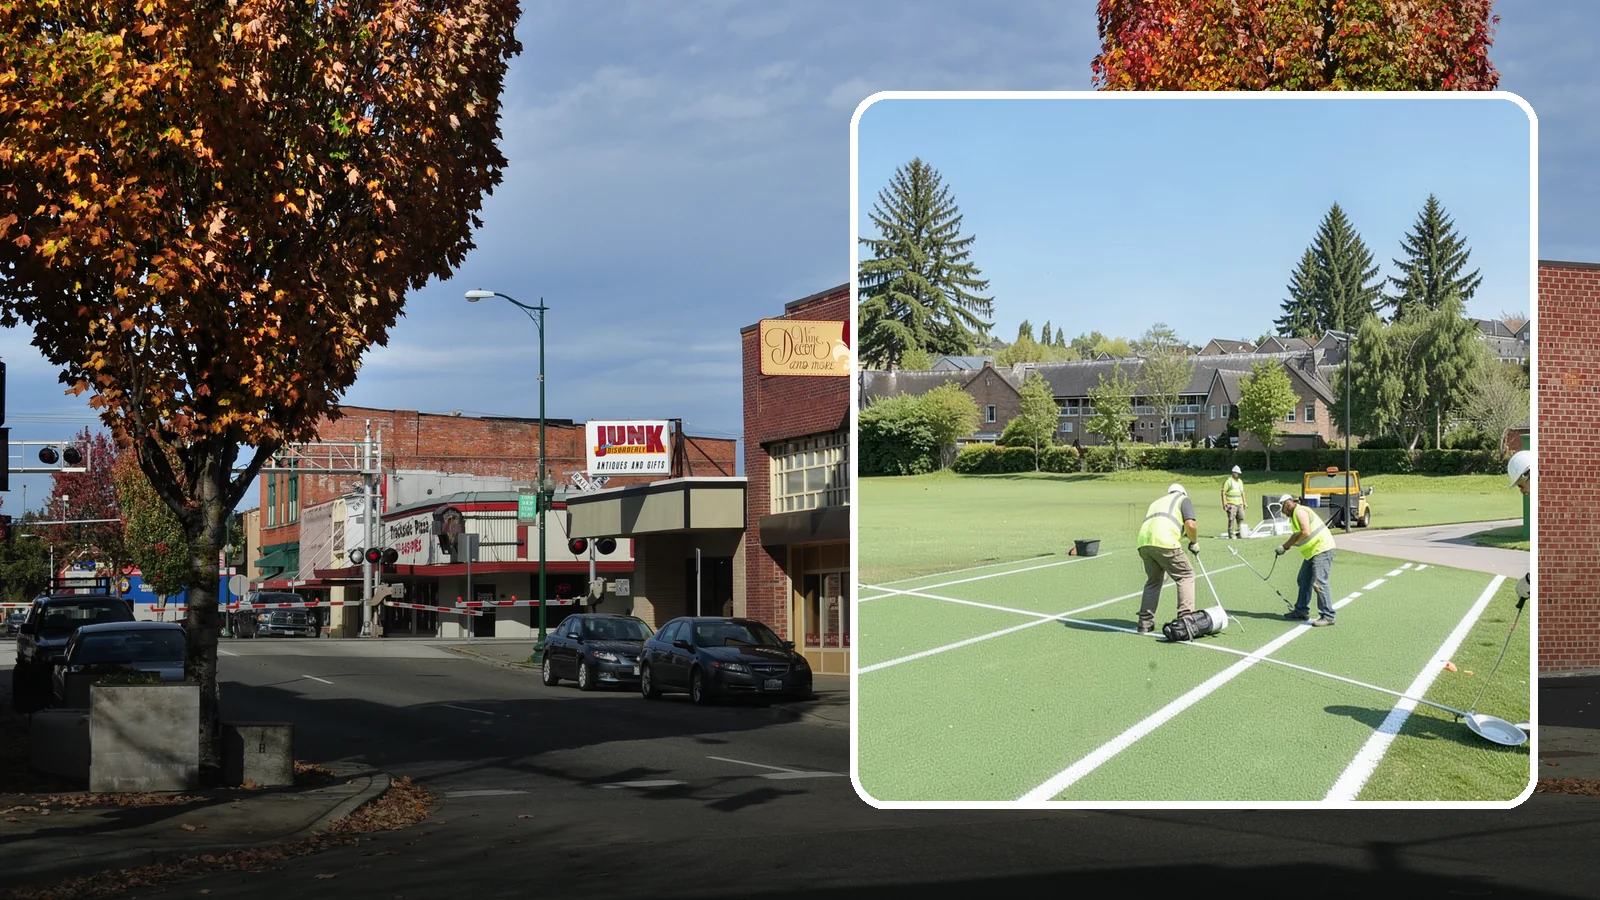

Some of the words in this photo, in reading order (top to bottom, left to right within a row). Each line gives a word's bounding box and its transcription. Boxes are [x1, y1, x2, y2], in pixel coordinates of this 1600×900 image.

[596, 425, 665, 457] JUNK
[597, 461, 628, 470] ANTIQUES
[631, 461, 644, 470] AND
[647, 460, 665, 470] GIFTS
[414, 519, 428, 535] Pizza
